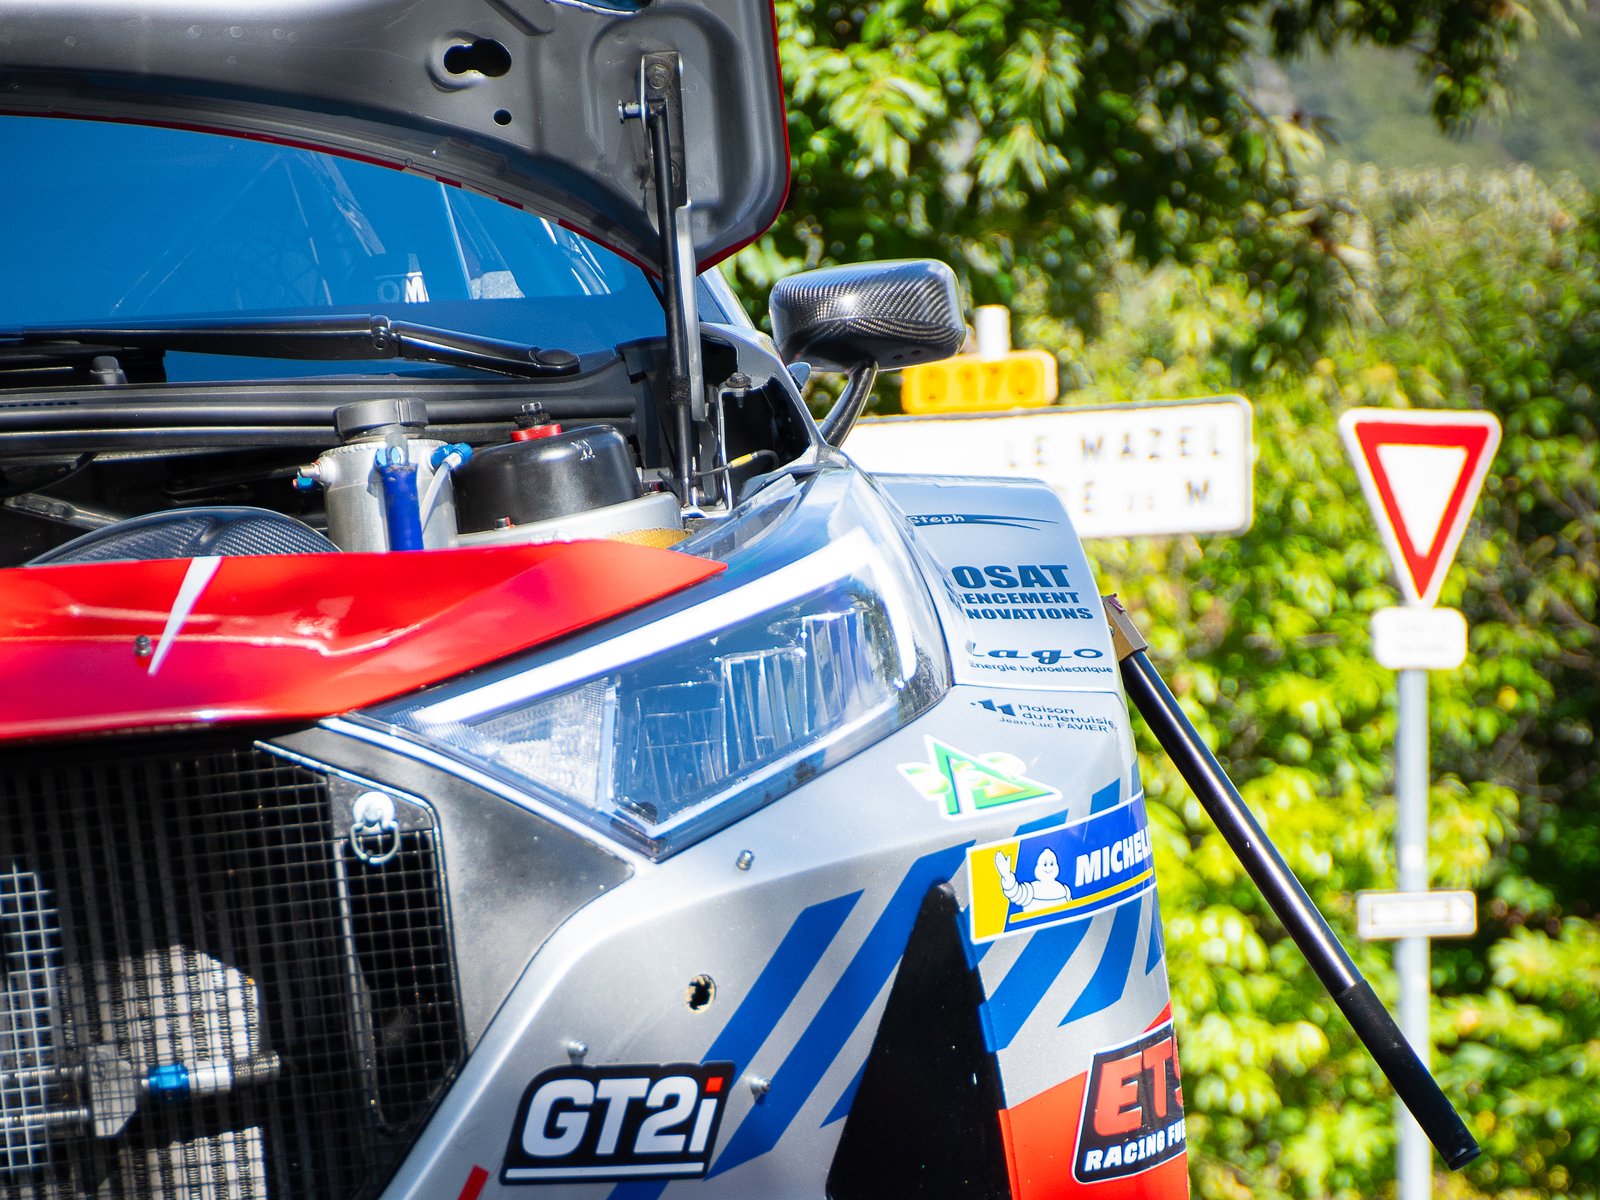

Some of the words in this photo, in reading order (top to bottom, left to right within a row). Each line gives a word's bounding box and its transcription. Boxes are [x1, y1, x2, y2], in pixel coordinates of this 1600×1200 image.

[957, 362, 1036, 402] 170
[906, 514, 965, 525] Steph
[1018, 704, 1075, 715] Maison
[1022, 712, 1043, 721] du
[1057, 722, 1109, 734] FAVIER
[522, 1076, 725, 1158] GT2i
[1084, 1130, 1166, 1172] RACING
